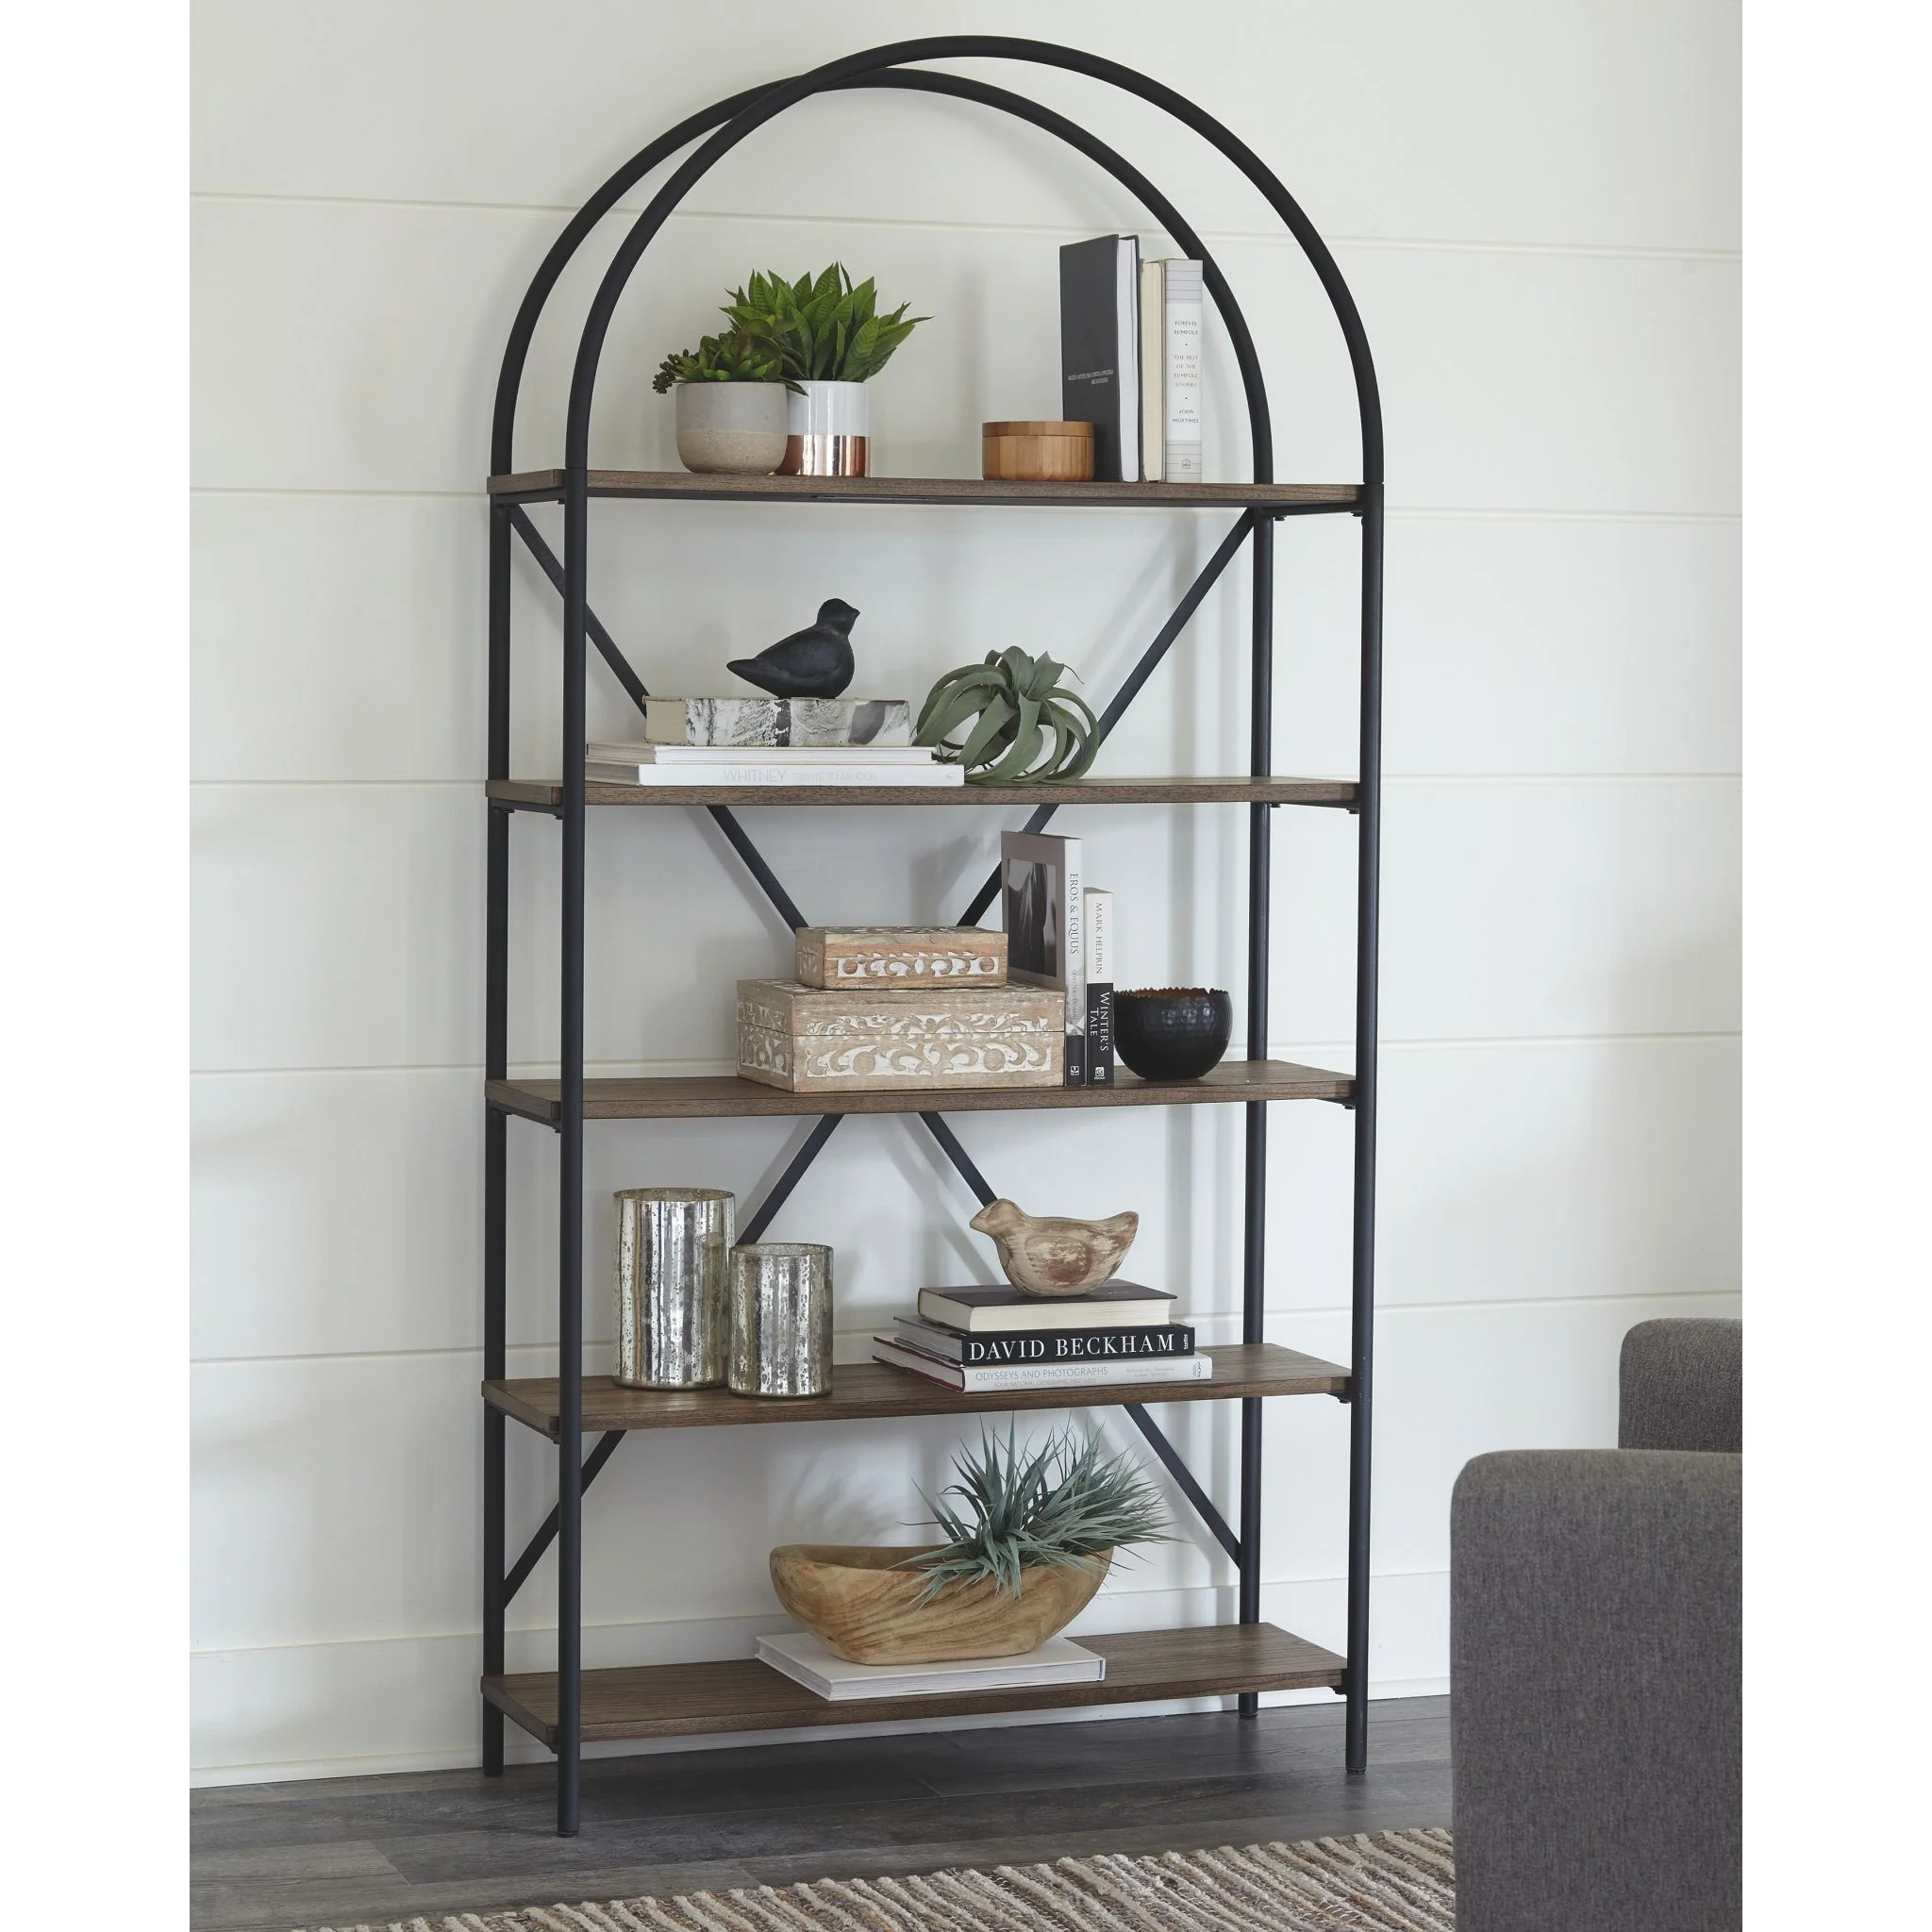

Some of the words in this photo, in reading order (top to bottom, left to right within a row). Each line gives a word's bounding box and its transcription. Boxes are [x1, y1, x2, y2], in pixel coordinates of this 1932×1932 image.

[723, 769, 787, 783] WHITNEY
[1070, 874, 1079, 903] EROS
[1070, 905, 1079, 914] &
[1069, 916, 1079, 955] EQUUS
[1090, 1008, 1099, 1037] TALE
[1099, 991, 1109, 1052] WINTER'S
[969, 1340, 1045, 1361] DAVID
[1055, 1333, 1175, 1357] BECKHAM
[975, 1371, 1019, 1381] ODYSSEYS
[1021, 1370, 1041, 1379] AND
[1042, 1366, 1108, 1378] PHOTOGRAPHS
